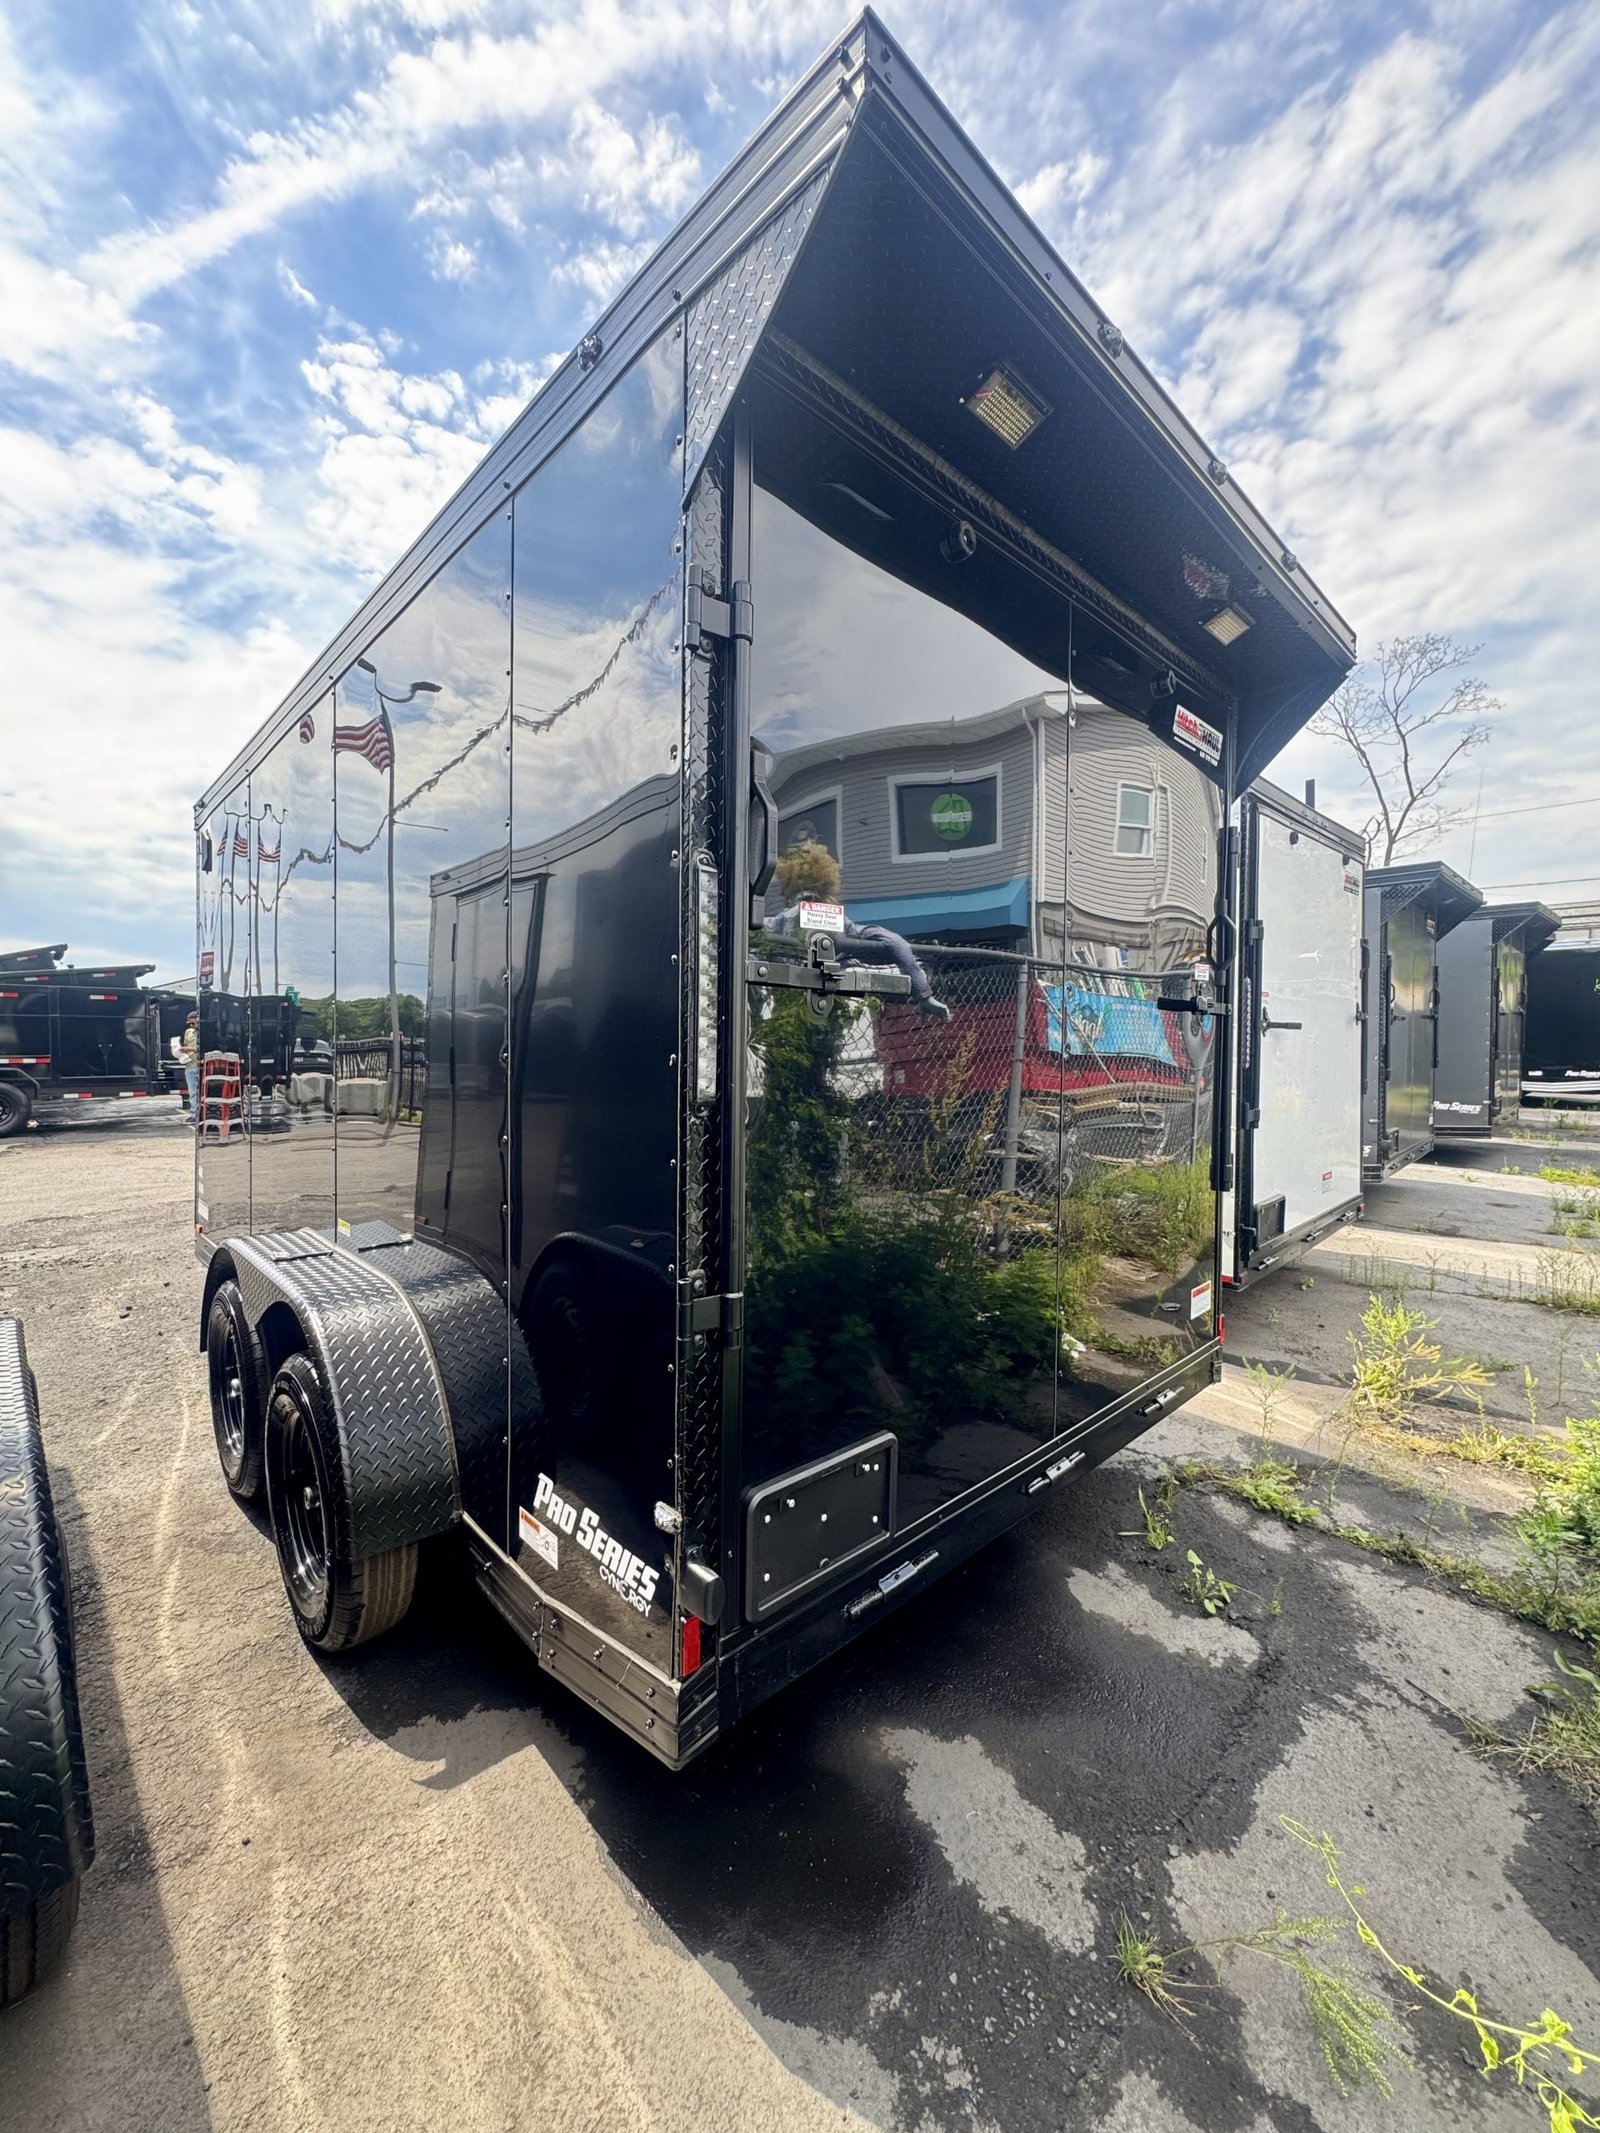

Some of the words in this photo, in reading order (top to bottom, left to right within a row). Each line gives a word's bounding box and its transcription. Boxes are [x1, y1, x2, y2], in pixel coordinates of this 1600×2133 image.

[811, 904, 841, 914] DANGER
[533, 1472, 577, 1535] PRO
[576, 1507, 660, 1601] SERIES
[599, 1565, 652, 1618] CYNERGY
